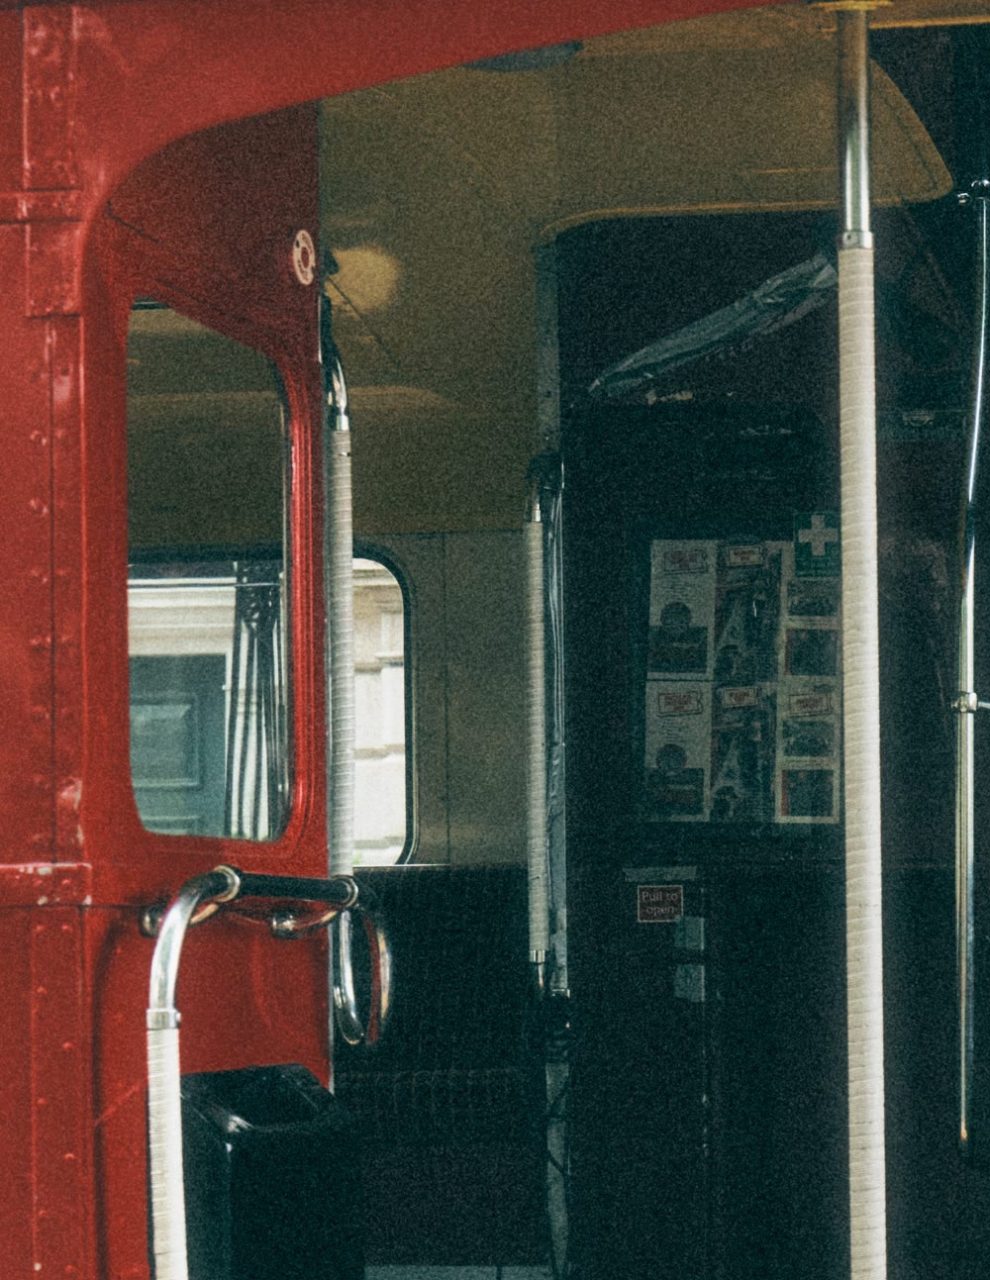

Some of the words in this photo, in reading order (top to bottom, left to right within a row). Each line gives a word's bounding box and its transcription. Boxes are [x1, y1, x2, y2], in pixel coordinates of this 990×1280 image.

[642, 891, 663, 902] Pull
[666, 891, 679, 902] to
[646, 905, 675, 917] open
